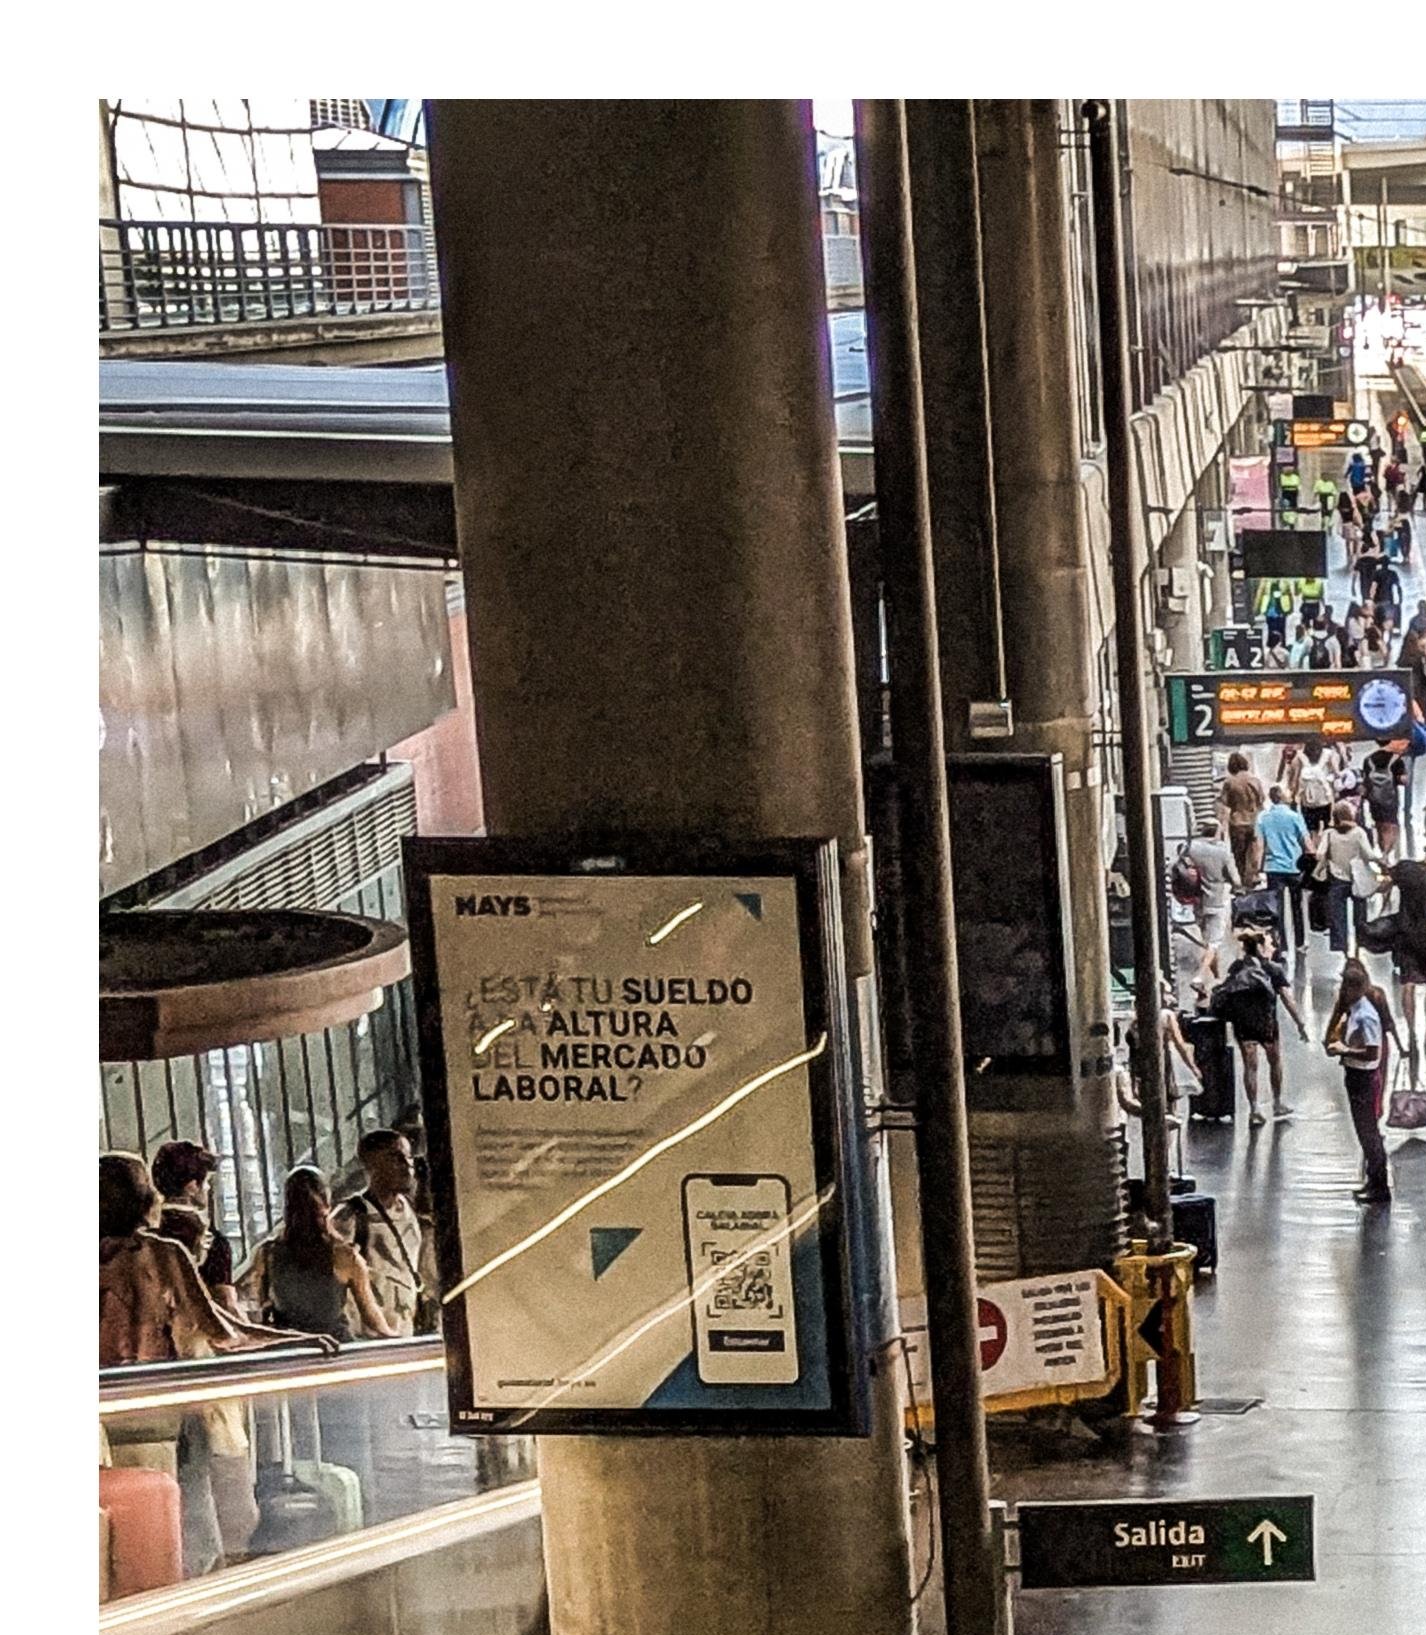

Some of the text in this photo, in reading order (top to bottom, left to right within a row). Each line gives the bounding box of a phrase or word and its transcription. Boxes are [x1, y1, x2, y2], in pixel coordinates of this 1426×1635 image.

[1225, 646, 1263, 668] A 2
[1194, 704, 1214, 737] 2
[570, 976, 613, 1004] TU
[623, 977, 753, 1005] SUELDO
[547, 1010, 678, 1037] ALTURA
[541, 1043, 706, 1070] MERCADO
[472, 1075, 643, 1102] LABORAL?
[1114, 1519, 1205, 1548] Salida
[1172, 1554, 1206, 1568] EXIT
